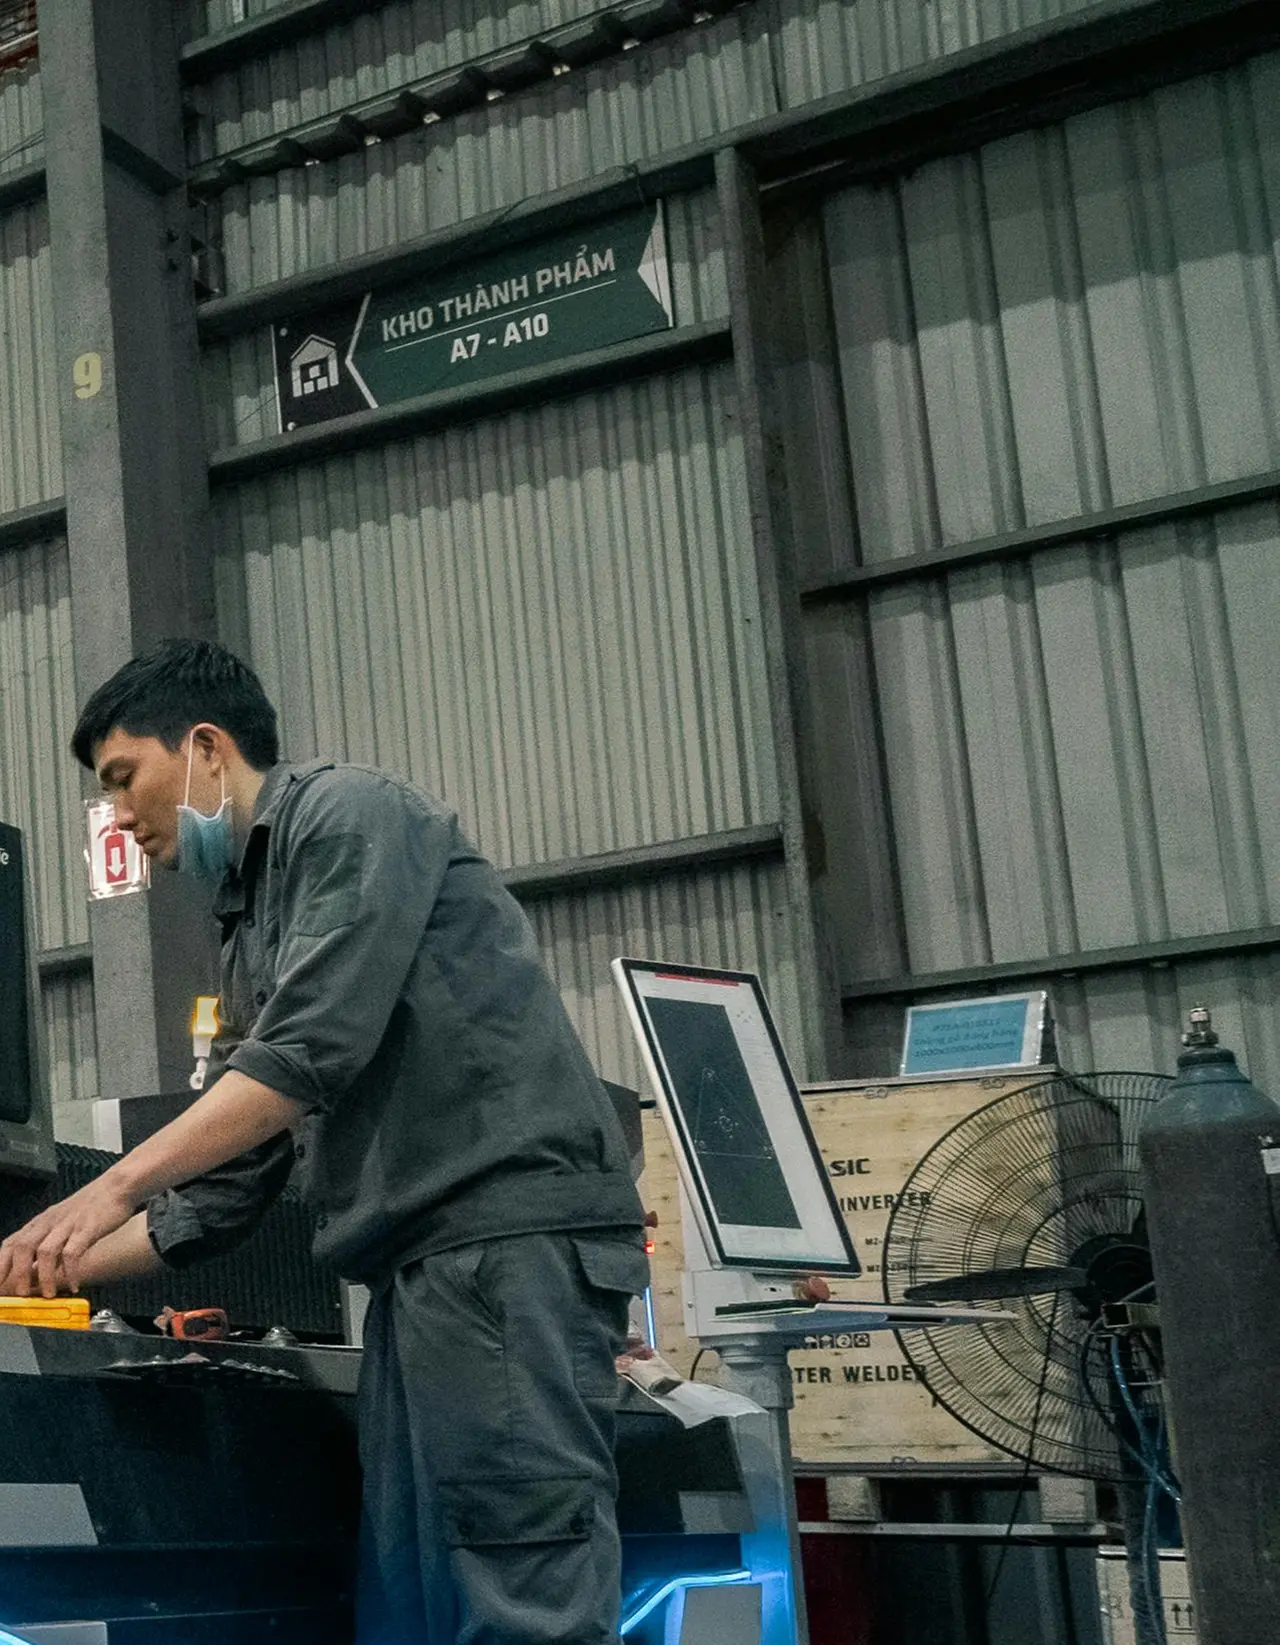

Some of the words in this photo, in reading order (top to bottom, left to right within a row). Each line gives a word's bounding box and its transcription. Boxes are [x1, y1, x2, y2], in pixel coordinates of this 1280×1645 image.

[381, 306, 434, 342] KHO
[438, 274, 530, 323] THÀNH
[535, 243, 617, 294] PHẨM
[450, 332, 481, 363] A7
[503, 312, 549, 348] A10
[73, 351, 102, 400] 9
[829, 1158, 872, 1177] SIC
[795, 1366, 831, 1384] TER
